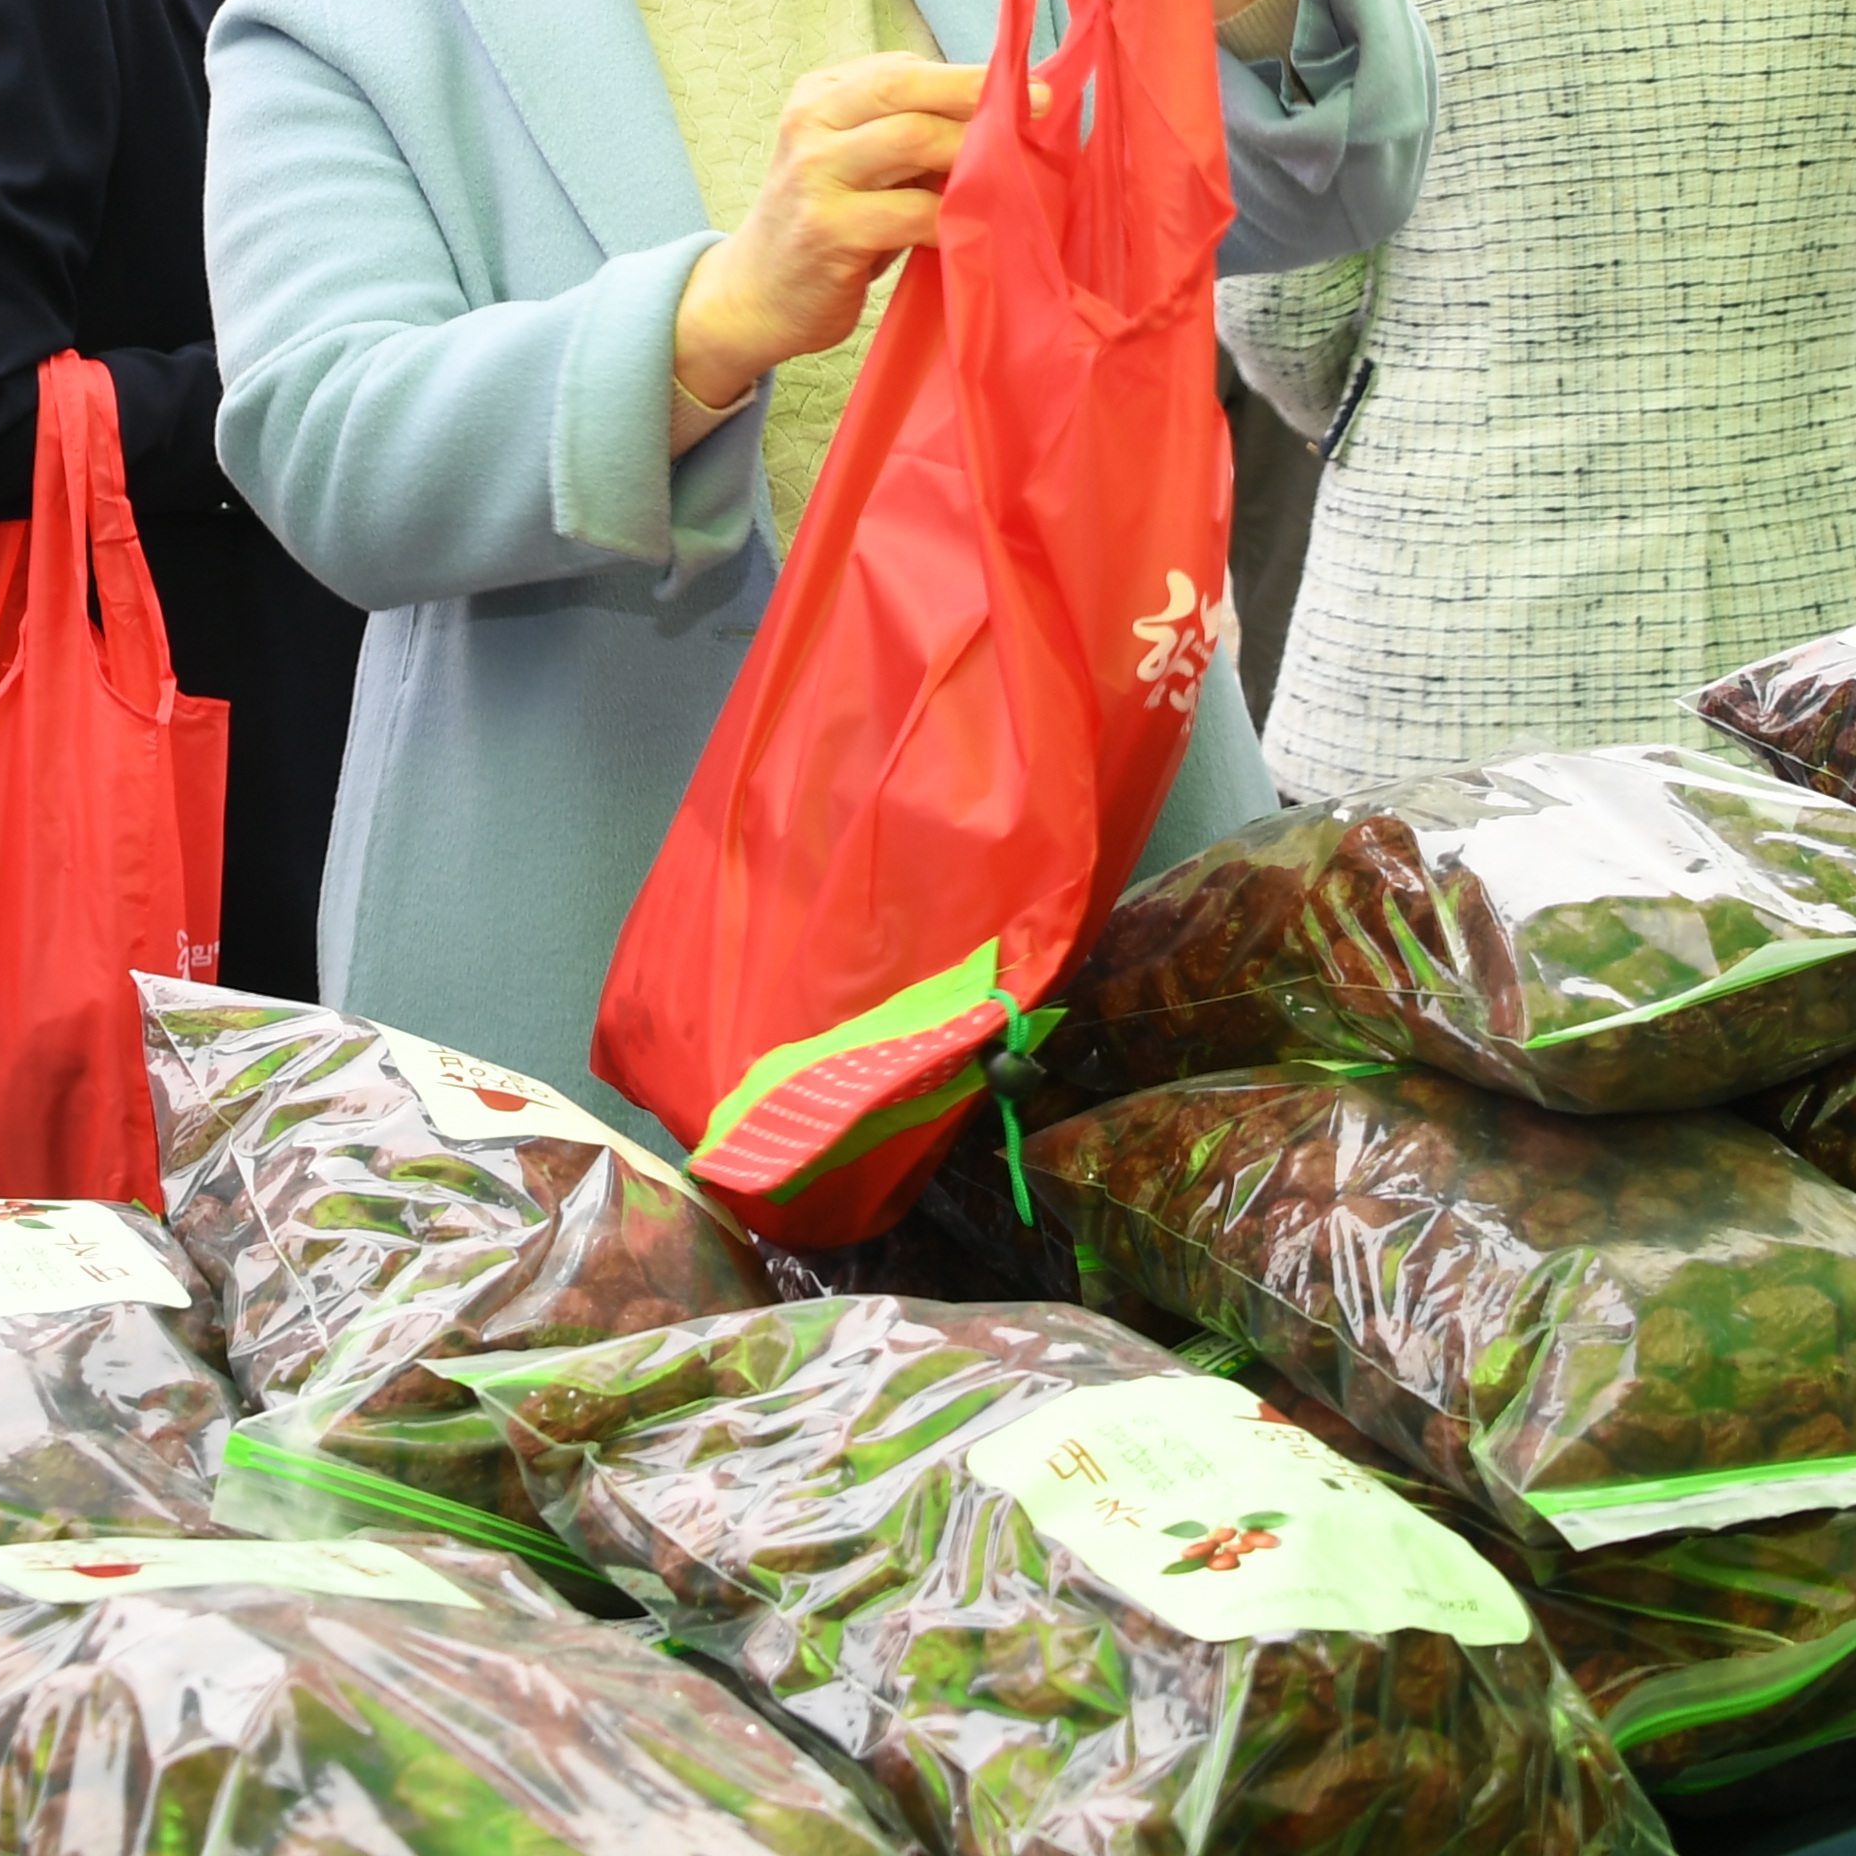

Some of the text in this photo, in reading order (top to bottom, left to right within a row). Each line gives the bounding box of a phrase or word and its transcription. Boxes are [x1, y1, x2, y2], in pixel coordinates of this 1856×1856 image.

[190, 940, 220, 968] 함
[54, 1233, 132, 1282] 대추
[1044, 1438, 1147, 1529] 대추
